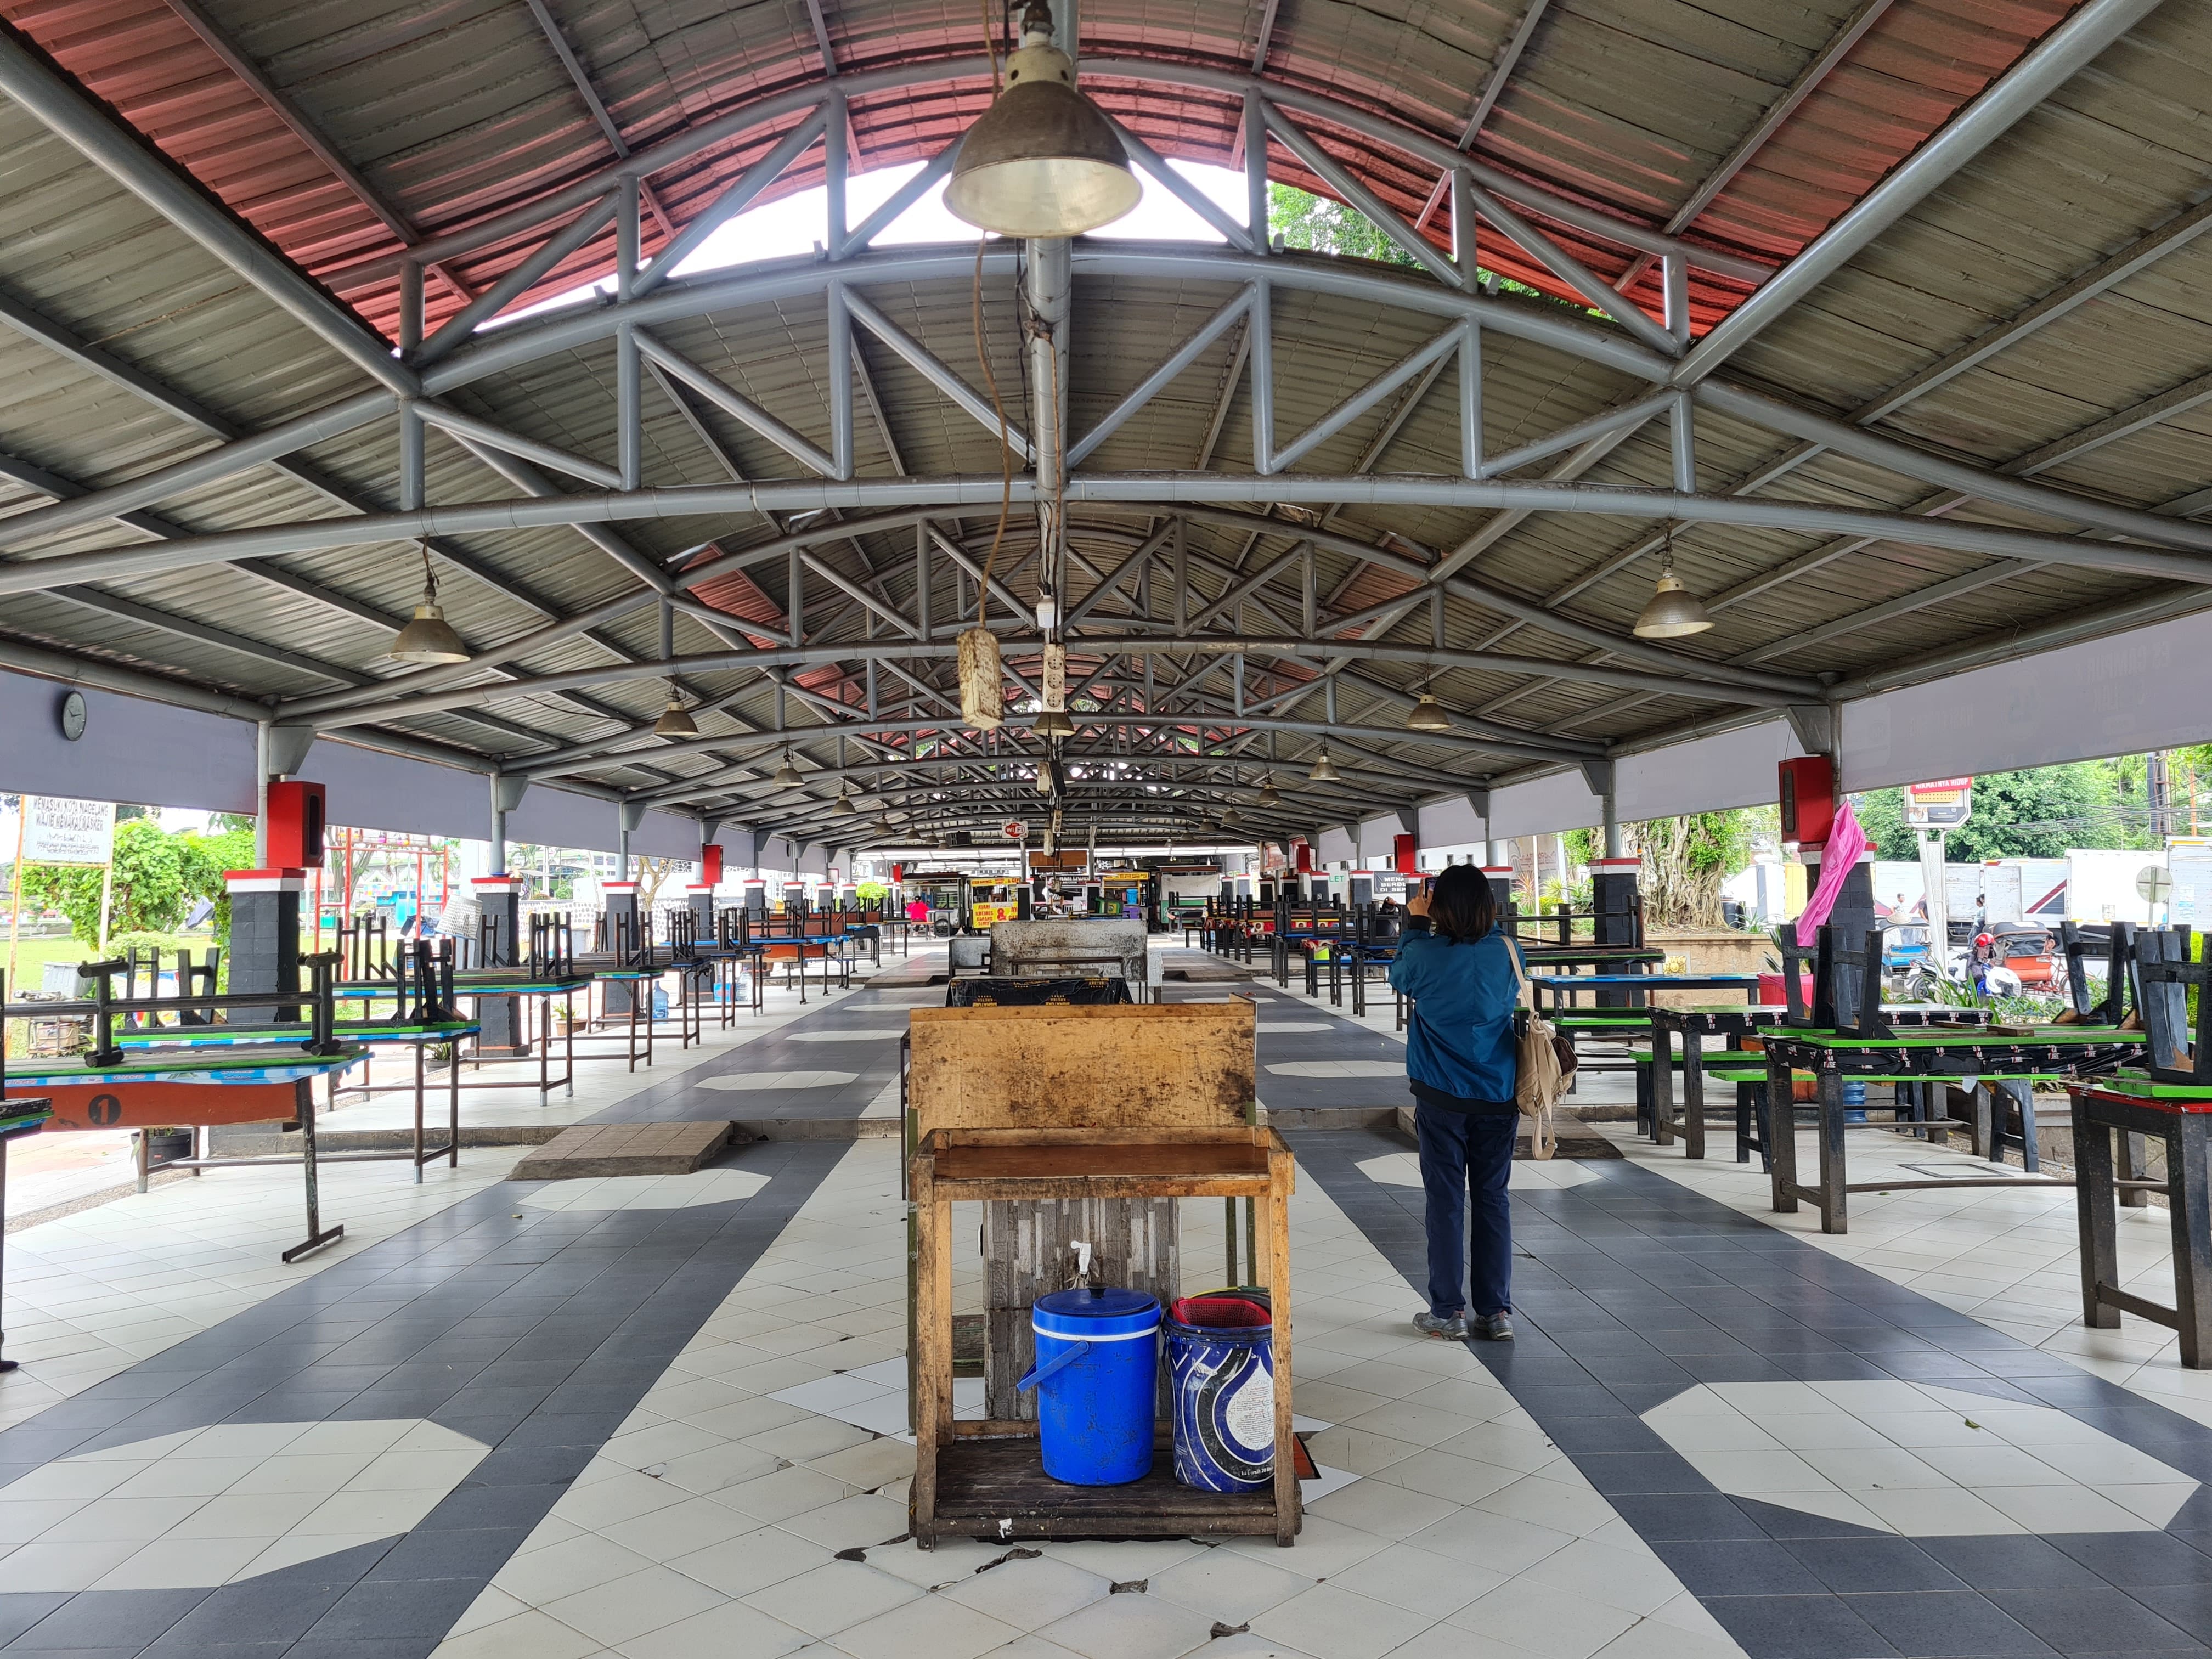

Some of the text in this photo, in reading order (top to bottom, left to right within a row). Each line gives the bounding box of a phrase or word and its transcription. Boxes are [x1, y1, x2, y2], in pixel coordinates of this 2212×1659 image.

[1915, 777, 1968, 789] NIKMATNYA HIDUP
[98, 1098, 109, 1125] 1
